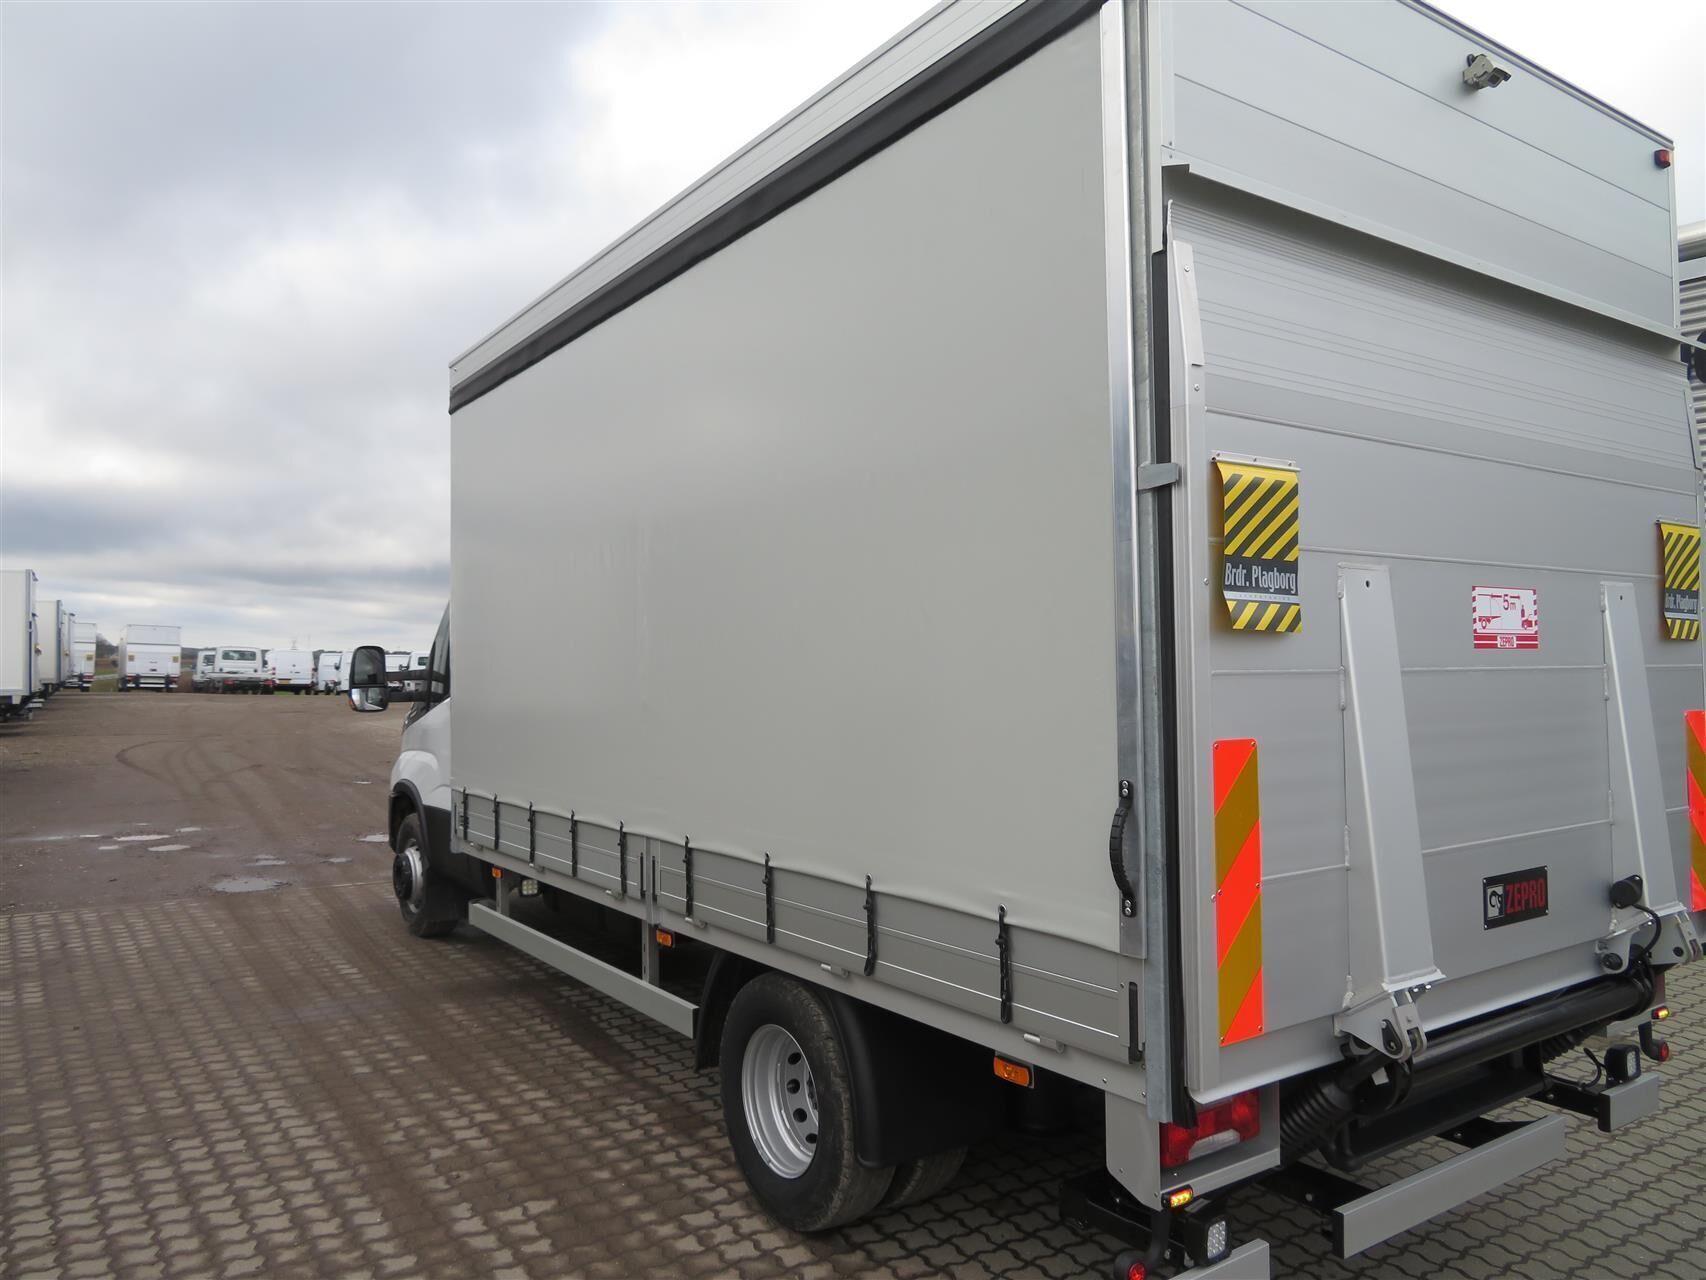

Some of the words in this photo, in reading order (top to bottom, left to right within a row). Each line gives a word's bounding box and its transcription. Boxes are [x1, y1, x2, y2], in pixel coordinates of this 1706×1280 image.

[1225, 562, 1250, 587] Brdr.
[1251, 565, 1296, 594] Plagborg
[1505, 878, 1546, 913] ZEPRO
